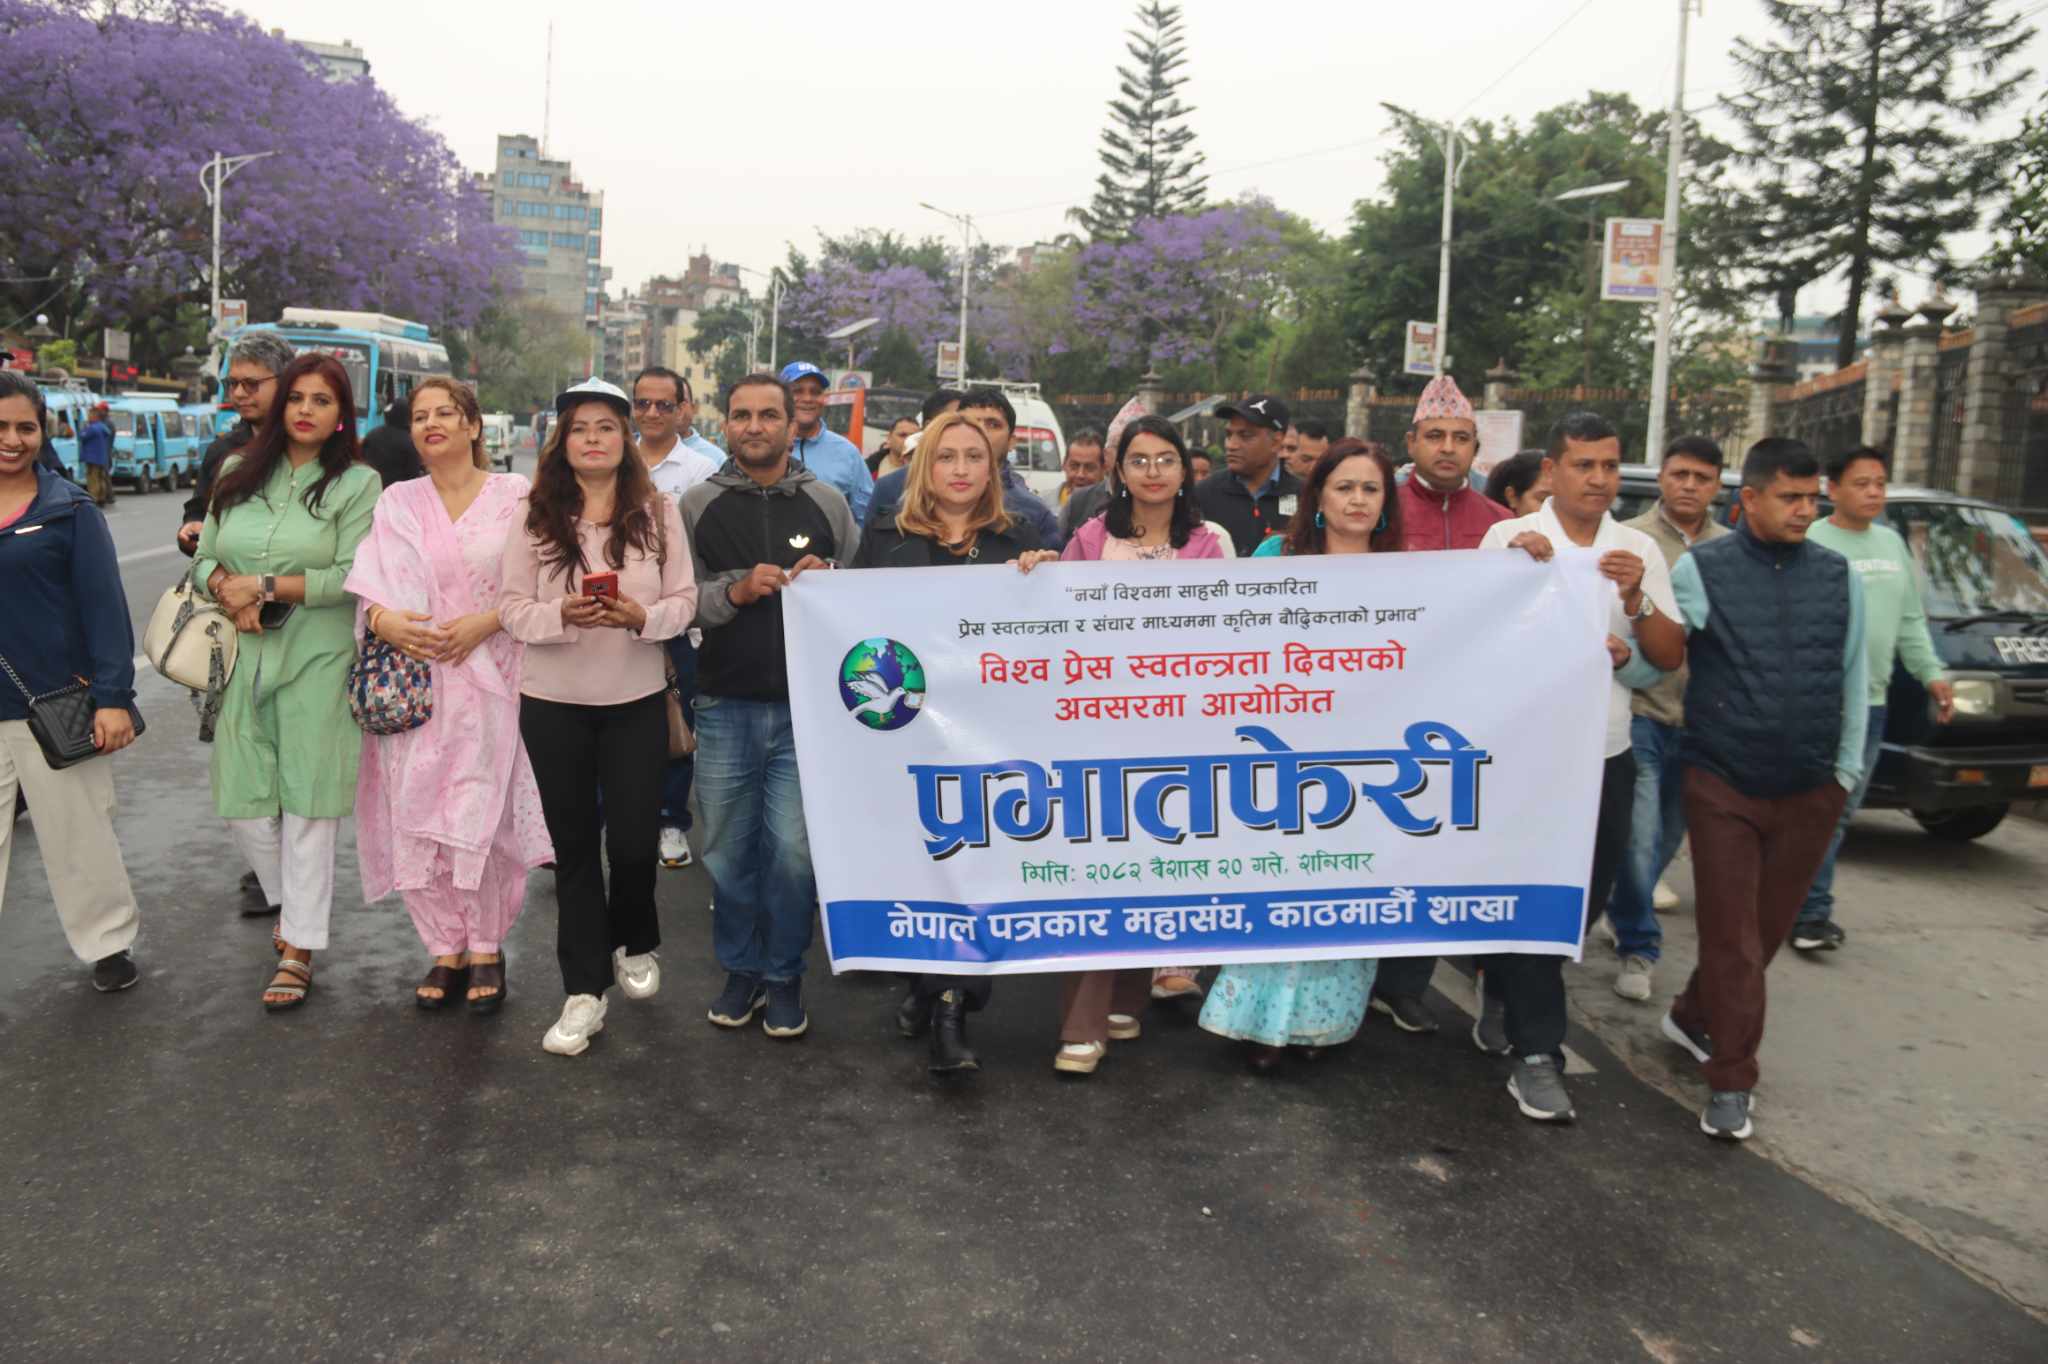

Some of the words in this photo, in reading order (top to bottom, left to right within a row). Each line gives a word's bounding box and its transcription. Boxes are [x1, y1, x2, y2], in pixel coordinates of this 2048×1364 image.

[1113, 582, 1171, 600] विश्वमा
[1178, 579, 1229, 600] साहसी
[1235, 577, 1318, 596] पत्रकारिता
[958, 619, 985, 638] प्रेस
[991, 619, 1069, 636] स्वतन्त्रता
[1075, 619, 1086, 632] र
[1093, 615, 1136, 632] संचार
[1142, 614, 1216, 630] माध्यममा
[979, 652, 1051, 685] विश्व
[1063, 649, 1114, 685] प्रेस
[1127, 650, 1271, 679] स्वतन्त्रता
[1283, 640, 1407, 677] दिवसको
[1054, 694, 1187, 721] अवसरमा
[1200, 684, 1335, 717] आयोजित
[907, 720, 1493, 861] प्रभातफेरी
[1086, 861, 1142, 884] २०८२
[1217, 857, 1243, 879] २०
[1298, 849, 1376, 876] शनिवार
[887, 902, 978, 942] नेपाल
[987, 909, 1112, 942] पत्रकार
[1122, 896, 1254, 940] महासंघ,
[1428, 895, 1520, 924] शाखा
